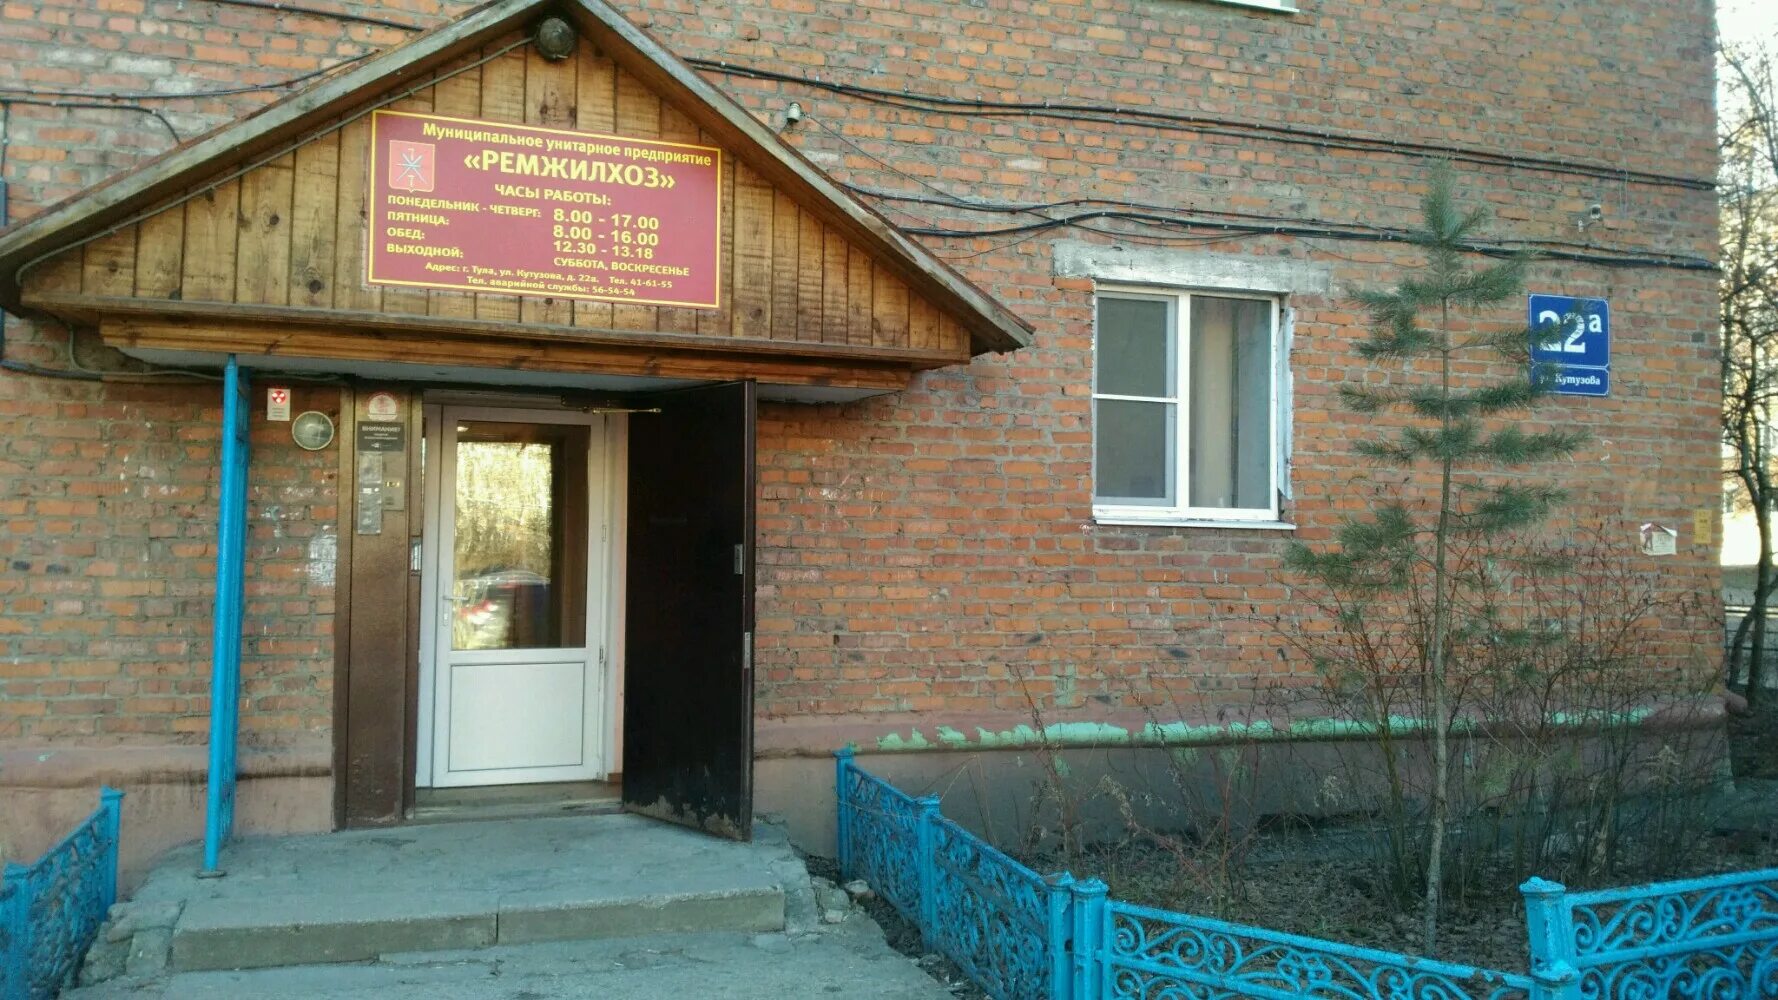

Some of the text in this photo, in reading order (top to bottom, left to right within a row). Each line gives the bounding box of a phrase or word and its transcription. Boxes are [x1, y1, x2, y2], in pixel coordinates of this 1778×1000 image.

[423, 123, 711, 166] Муниципальное унитарное предприятие
[464, 150, 675, 189] «РЕМЖИЛХОЗ»
[495, 184, 611, 205] ЧАСЫ РАБОТЫ:
[388, 195, 479, 211] ПОНЕДЕЛЬНИК
[490, 204, 541, 217] ЧЕТВЕРГ:
[553, 209, 592, 223] 8.00
[612, 214, 659, 230] 17.00
[387, 227, 425, 239] ОБЕД:
[553, 241, 595, 254] 12.30
[612, 246, 653, 259] 13.18
[388, 212, 449, 226] ПЯТНИЦА:
[553, 225, 592, 240] 8.00
[611, 231, 658, 246] 16.00
[387, 243, 689, 276] ВЫХОДНОЙ: СУББОТА, ВОСКРЕСЕНЬЕ
[425, 262, 460, 273] Адрес:
[473, 265, 497, 276] Тула,
[500, 268, 514, 276] ул.
[609, 276, 628, 285] Тел.
[630, 278, 673, 288] 41-61-55
[467, 276, 487, 285] Тел.
[489, 278, 545, 289] аварийной
[547, 283, 589, 293] службы:
[1555, 373, 1601, 386] Кутузова
